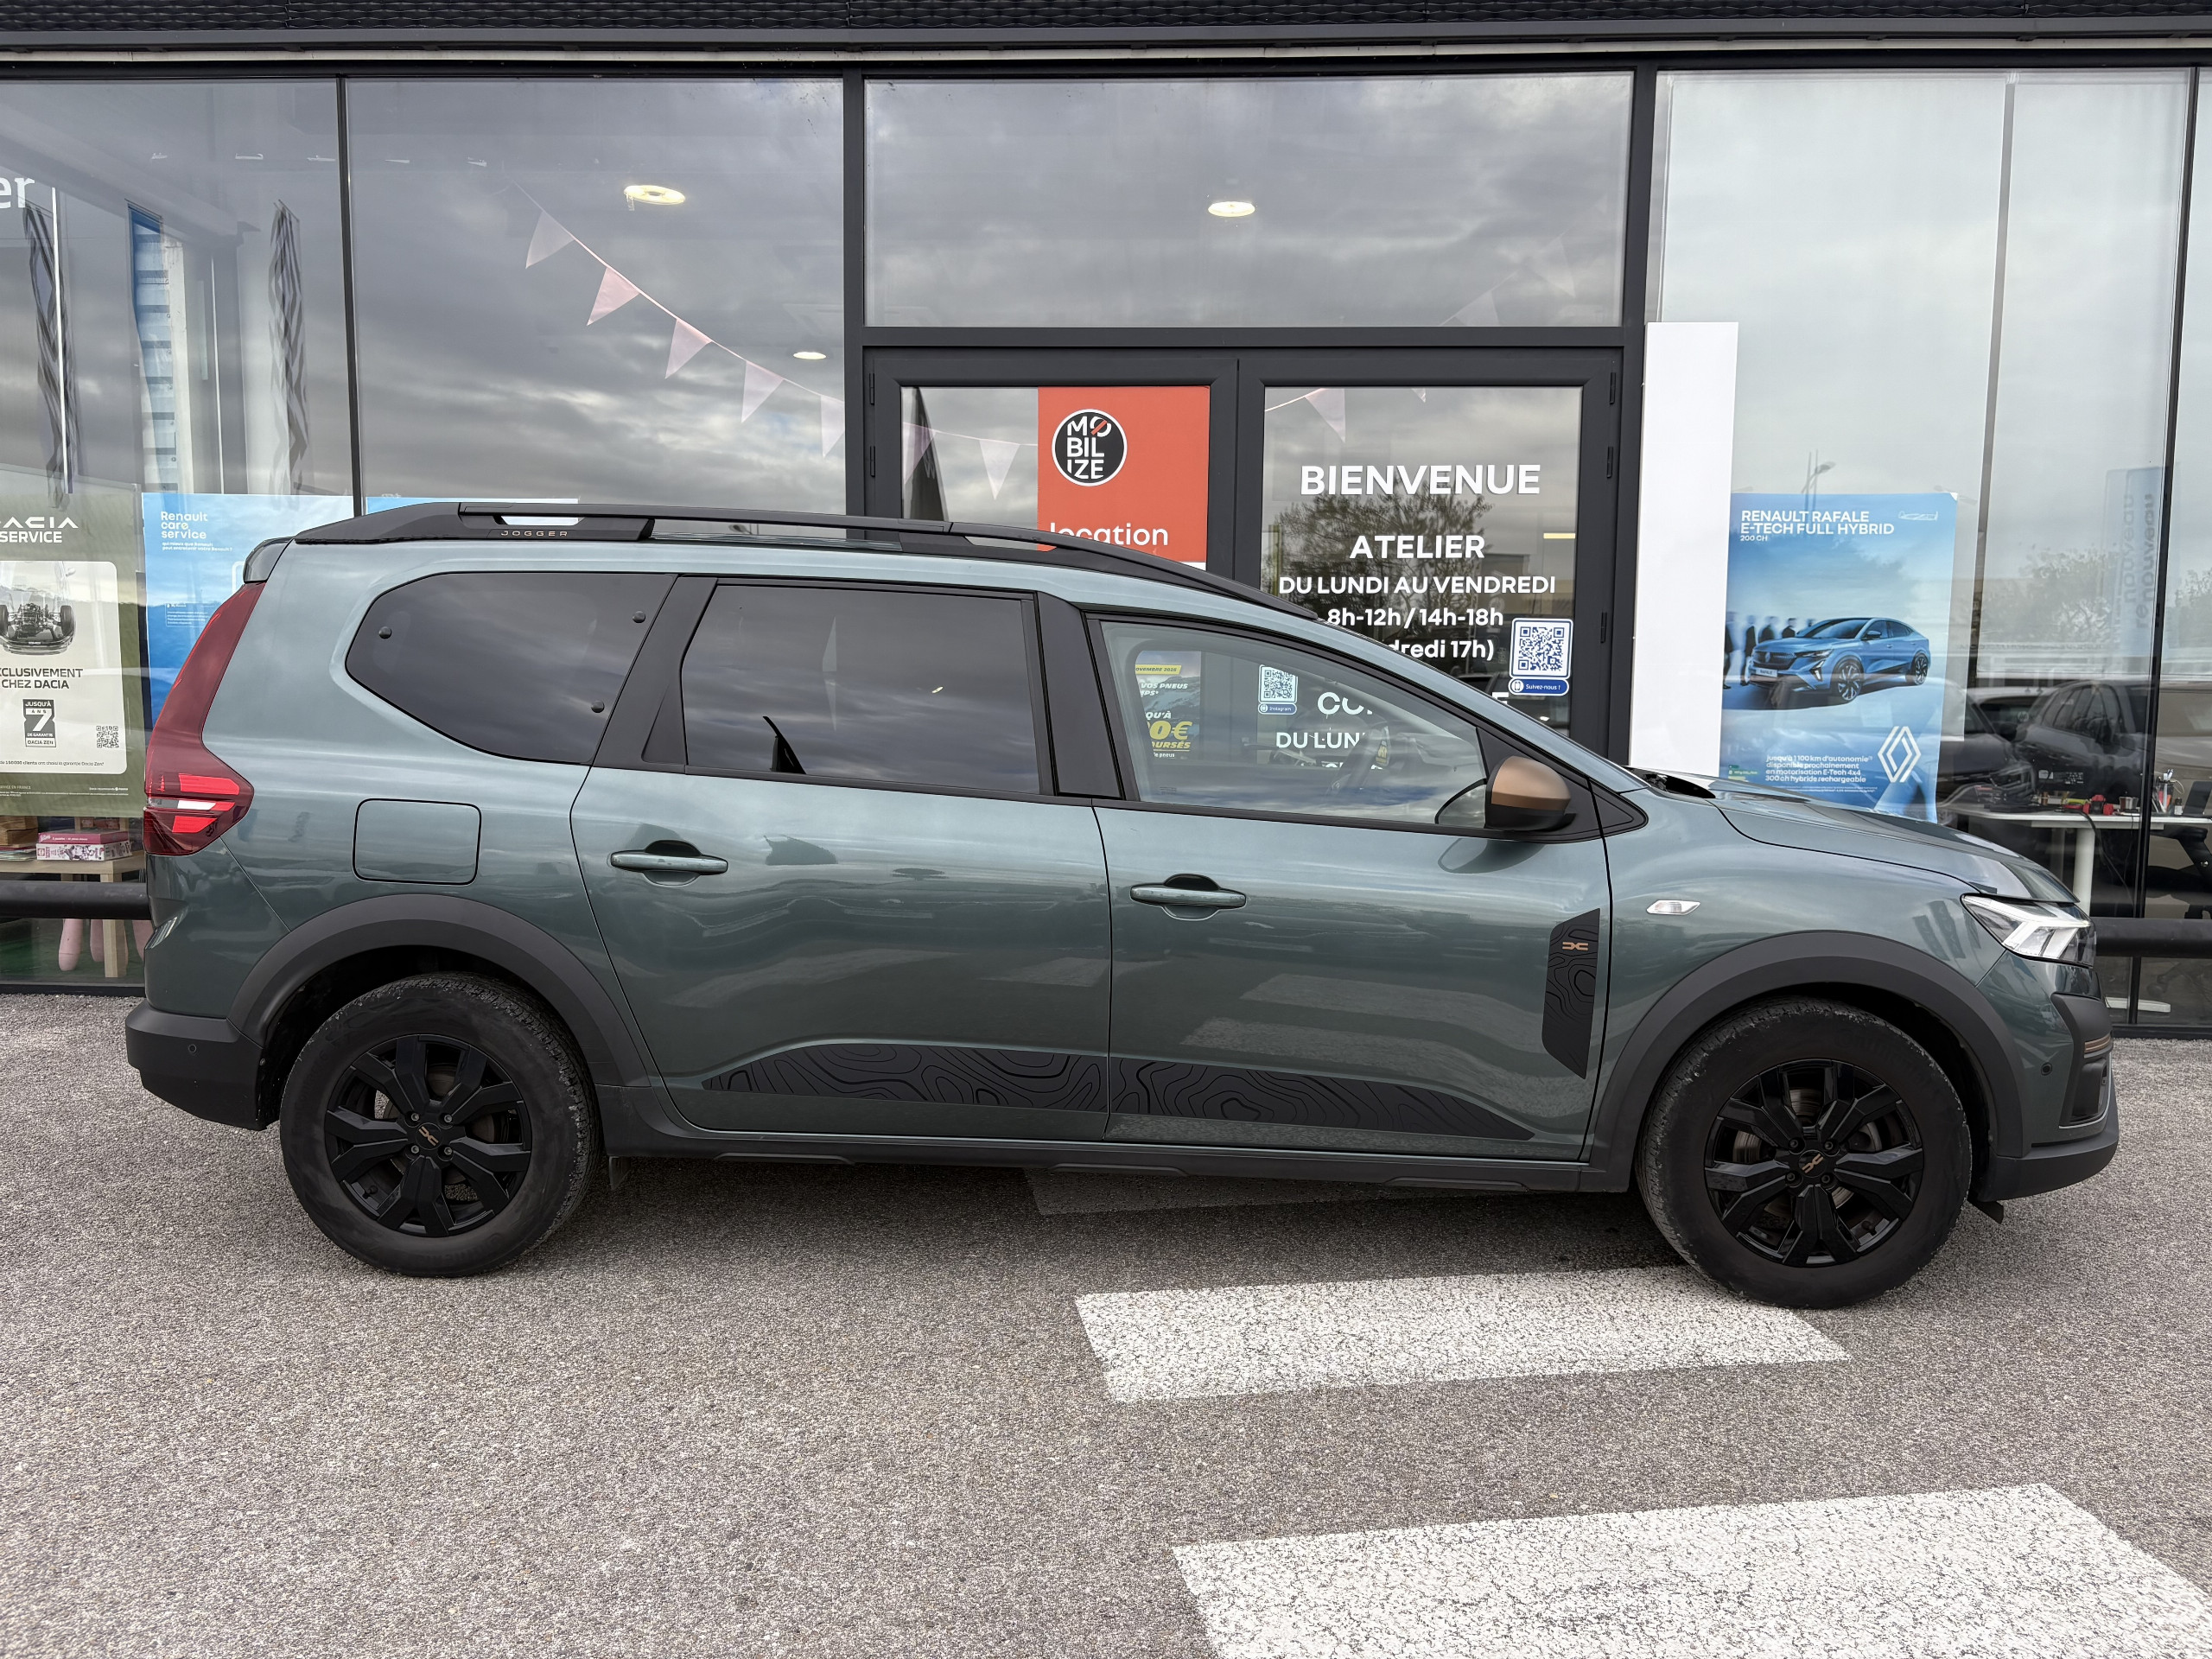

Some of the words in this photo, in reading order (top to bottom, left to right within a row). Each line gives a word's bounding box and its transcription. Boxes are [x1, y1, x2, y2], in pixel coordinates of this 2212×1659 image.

[1300, 465, 1541, 495] BIENVENUE
[0, 517, 79, 528] ACIA
[161, 512, 207, 521] Renault
[1742, 511, 1808, 522] RENAULT
[1812, 511, 1869, 523] RAFALE
[162, 530, 207, 538] service
[1741, 523, 1793, 534] E-TECH
[1797, 523, 1834, 534] FULL
[1838, 524, 1894, 535] HYBRID
[0, 531, 62, 543] SERVICE
[1350, 535, 1485, 558] ATELIER
[1279, 576, 1312, 594] DU
[1318, 576, 1389, 594] LUNDI
[1394, 576, 1427, 594] AU
[1432, 576, 1555, 594] VENDREDI
[1451, 639, 1494, 661] 17h)
[0, 668, 83, 677] CLUSIVEMENT
[2, 679, 32, 689] CHEZ
[35, 679, 69, 690] DACIA
[1276, 733, 1307, 748] DU
[1790, 775, 1817, 784] hybride
